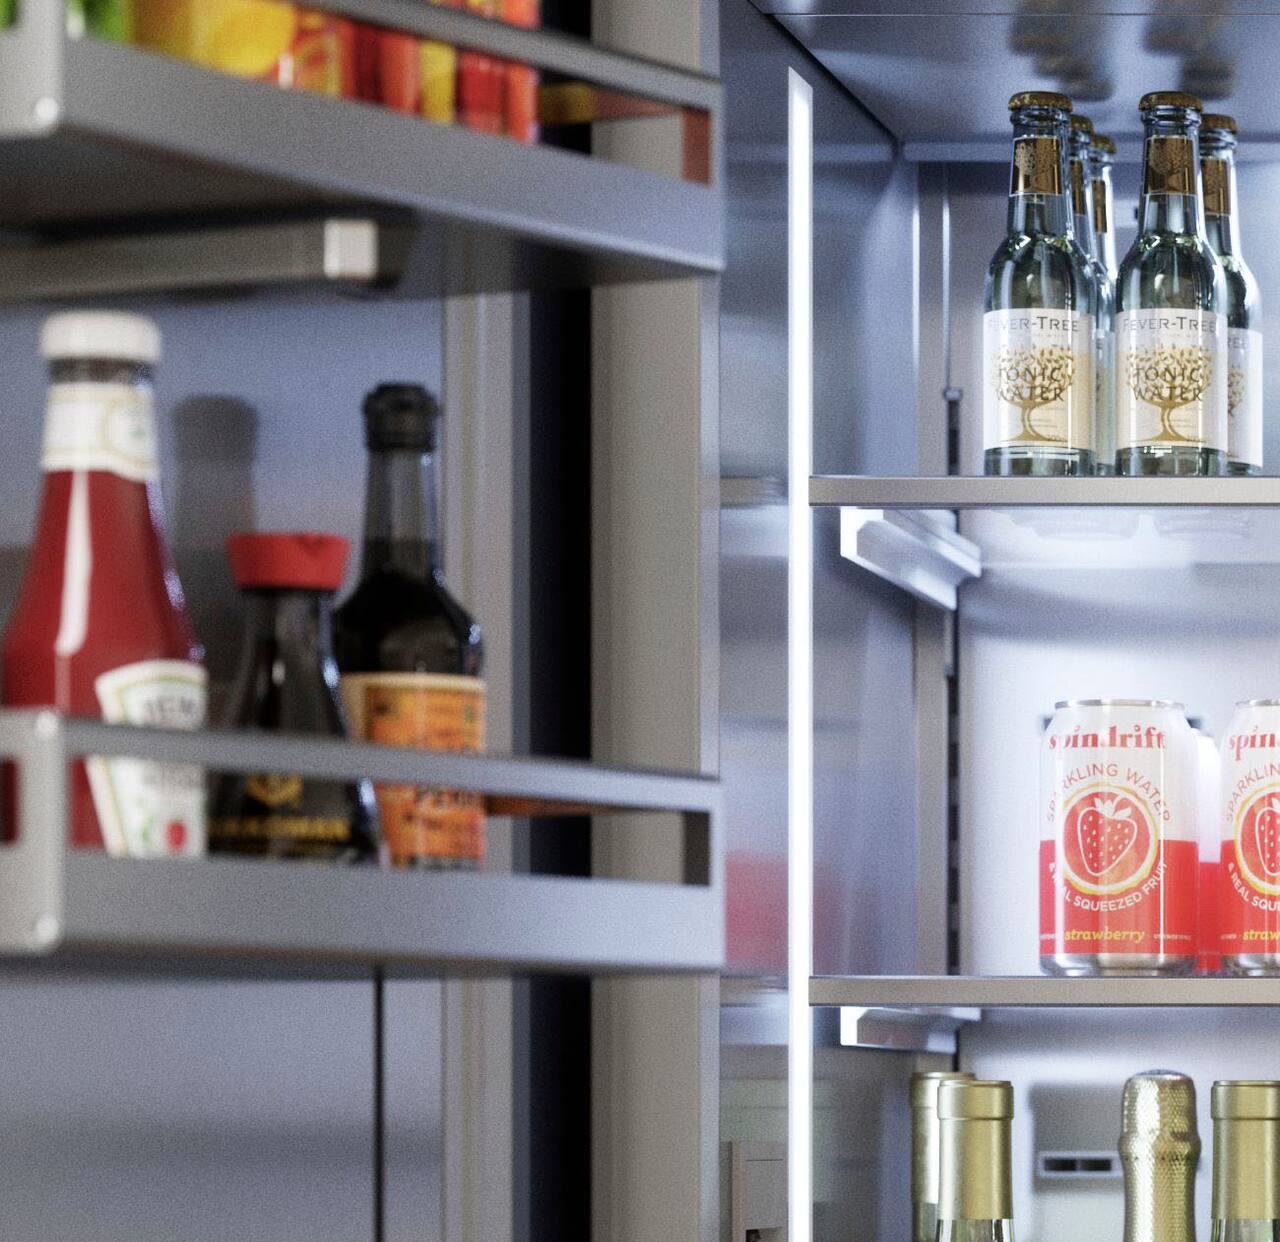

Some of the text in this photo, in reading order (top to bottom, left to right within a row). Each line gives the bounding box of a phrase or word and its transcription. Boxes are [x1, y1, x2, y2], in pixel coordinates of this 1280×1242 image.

[987, 316, 1081, 332] FER-TREE
[1133, 367, 1201, 383] TONIC
[1046, 763, 1119, 822] SPKLING
[1073, 890, 1143, 912] SQUEEZED
[1064, 926, 1145, 944] strawberry
